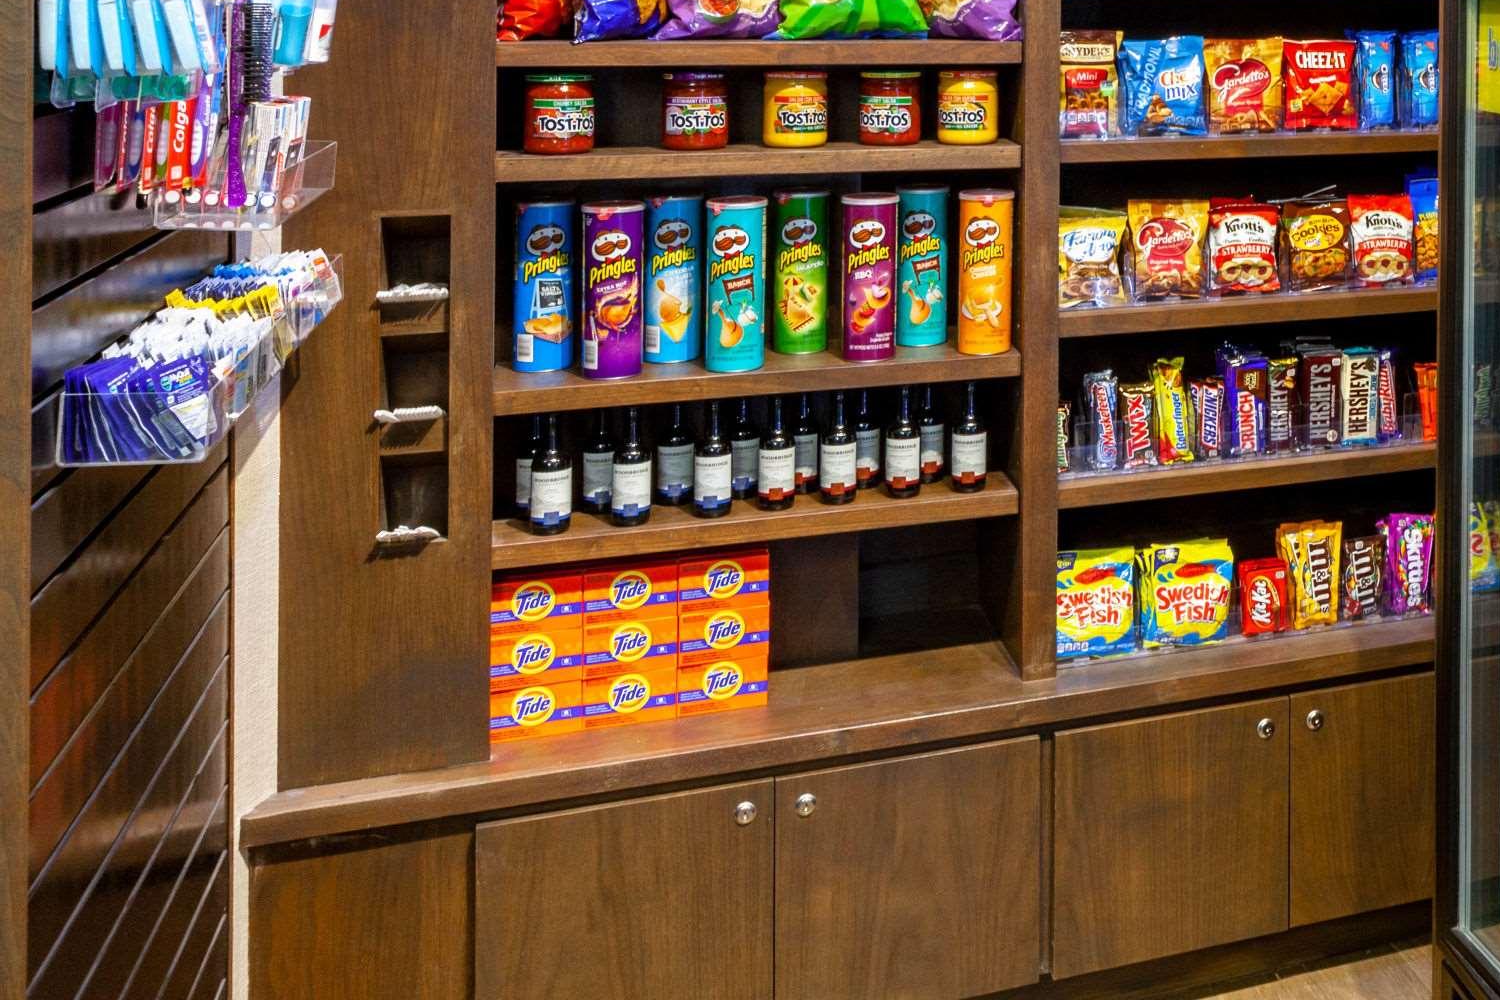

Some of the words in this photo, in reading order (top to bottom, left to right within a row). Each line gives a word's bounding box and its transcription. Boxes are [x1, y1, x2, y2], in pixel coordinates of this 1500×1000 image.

[1077, 70, 1098, 81] Mini
[1165, 85, 1196, 101] mix
[539, 114, 594, 132] TOSTITOS
[670, 112, 725, 130] TOSTITOS
[781, 111, 827, 126] TOSTITOS
[1225, 217, 1264, 233] Knott's
[1292, 223, 1340, 241] Cookies
[1366, 214, 1403, 229] Knott's
[901, 236, 940, 262] Pringles
[1222, 245, 1270, 255] STRAWBERRY
[1364, 239, 1407, 249] STRAWBERRY
[524, 251, 569, 283] Pringles
[651, 248, 696, 276] Pringles
[710, 255, 754, 283] Pringles
[780, 243, 822, 271] Pringles
[848, 247, 890, 272] Pringles
[964, 244, 1004, 272] Pringles
[589, 258, 636, 288] Pringles
[1271, 379, 1289, 441] HERSHEY'S
[1310, 363, 1332, 440] HERSHEY'S
[1349, 361, 1368, 434] HERSHEY'S
[1127, 395, 1150, 458] TWIX
[1172, 393, 1186, 450] Butterfinger
[1203, 388, 1217, 448] SNICKERS
[1240, 392, 1256, 451] CRUNCH
[1404, 529, 1424, 607] Skittles
[615, 580, 647, 605] Tide
[708, 569, 741, 593] Tide
[516, 591, 551, 616] Tide
[1156, 583, 1229, 611] Swedish
[1076, 606, 1118, 627] Fish
[1174, 602, 1215, 623] Fish
[615, 632, 647, 656] Tide
[709, 620, 742, 644] Tide
[516, 645, 551, 669] Tide
[613, 683, 646, 708] Tide
[707, 671, 739, 695] Tide
[516, 696, 551, 721] Tide
